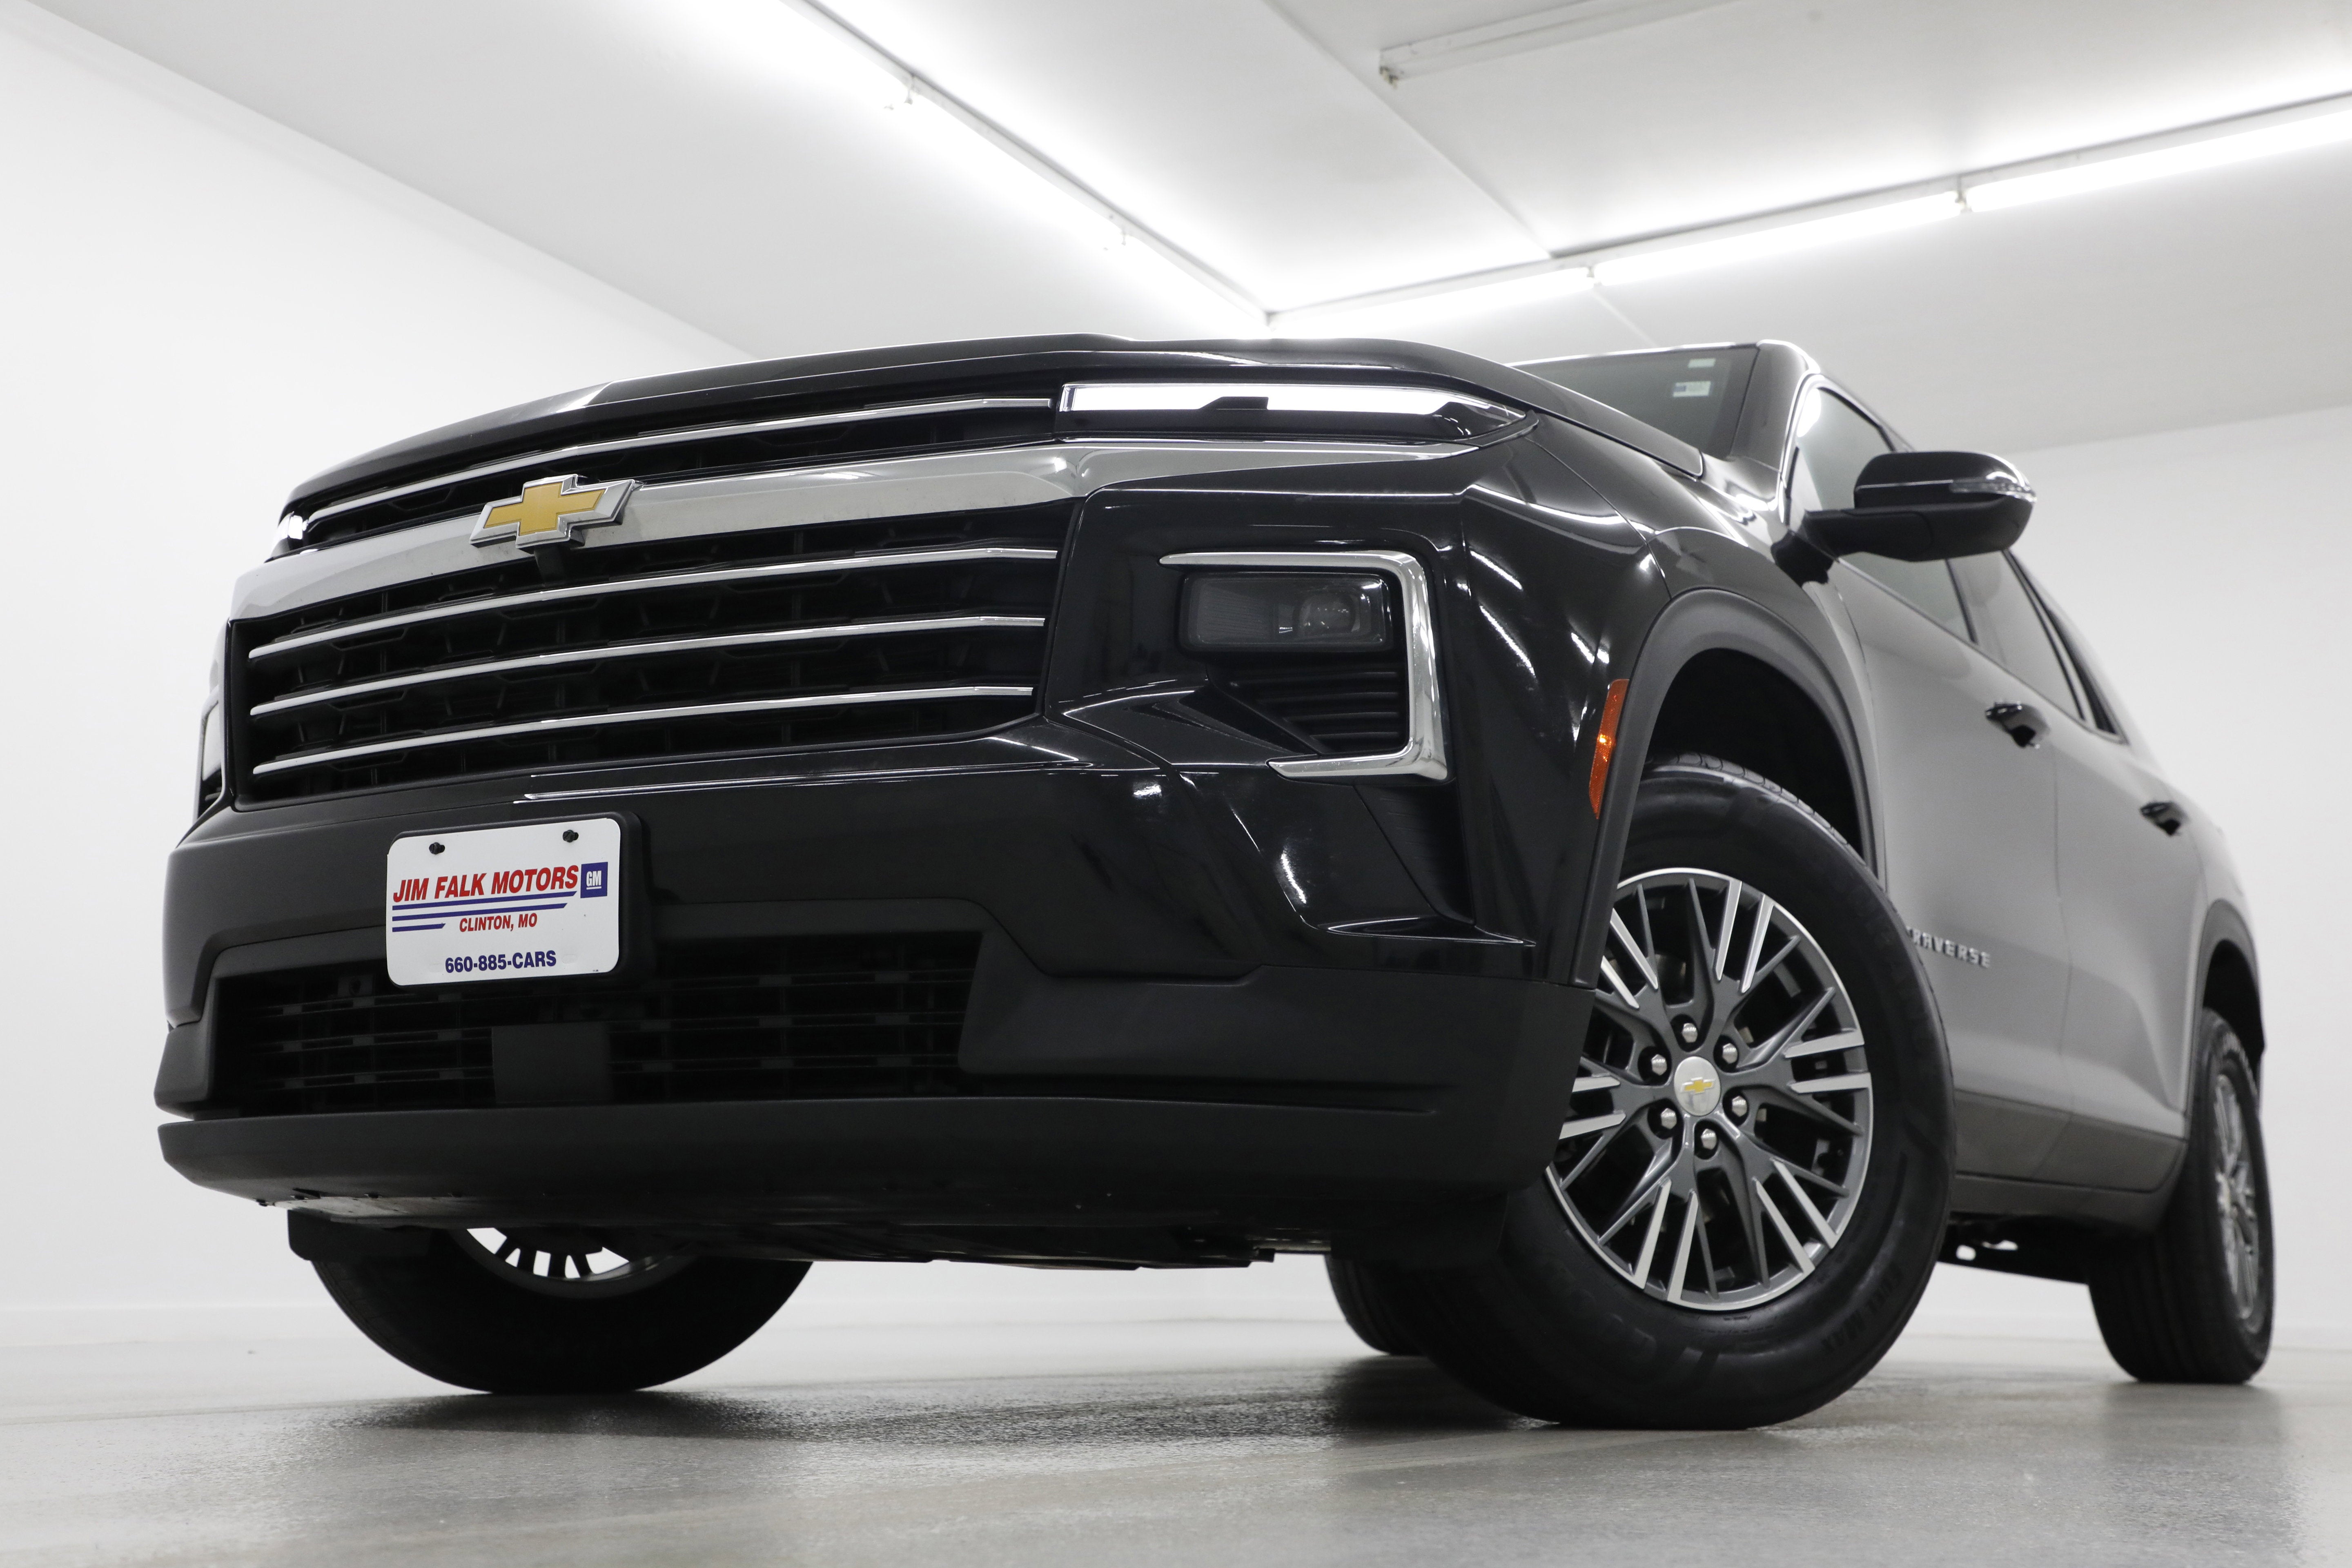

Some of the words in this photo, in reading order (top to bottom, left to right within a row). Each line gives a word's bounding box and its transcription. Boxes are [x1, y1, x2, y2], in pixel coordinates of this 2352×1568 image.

[393, 878, 429, 902] JIM
[434, 873, 487, 899] FALK
[491, 865, 579, 894] MOTORS
[586, 870, 602, 887] GM
[459, 915, 514, 932] CLINTON,
[518, 913, 537, 928] MO
[445, 950, 556, 973] 660-885-CARS
